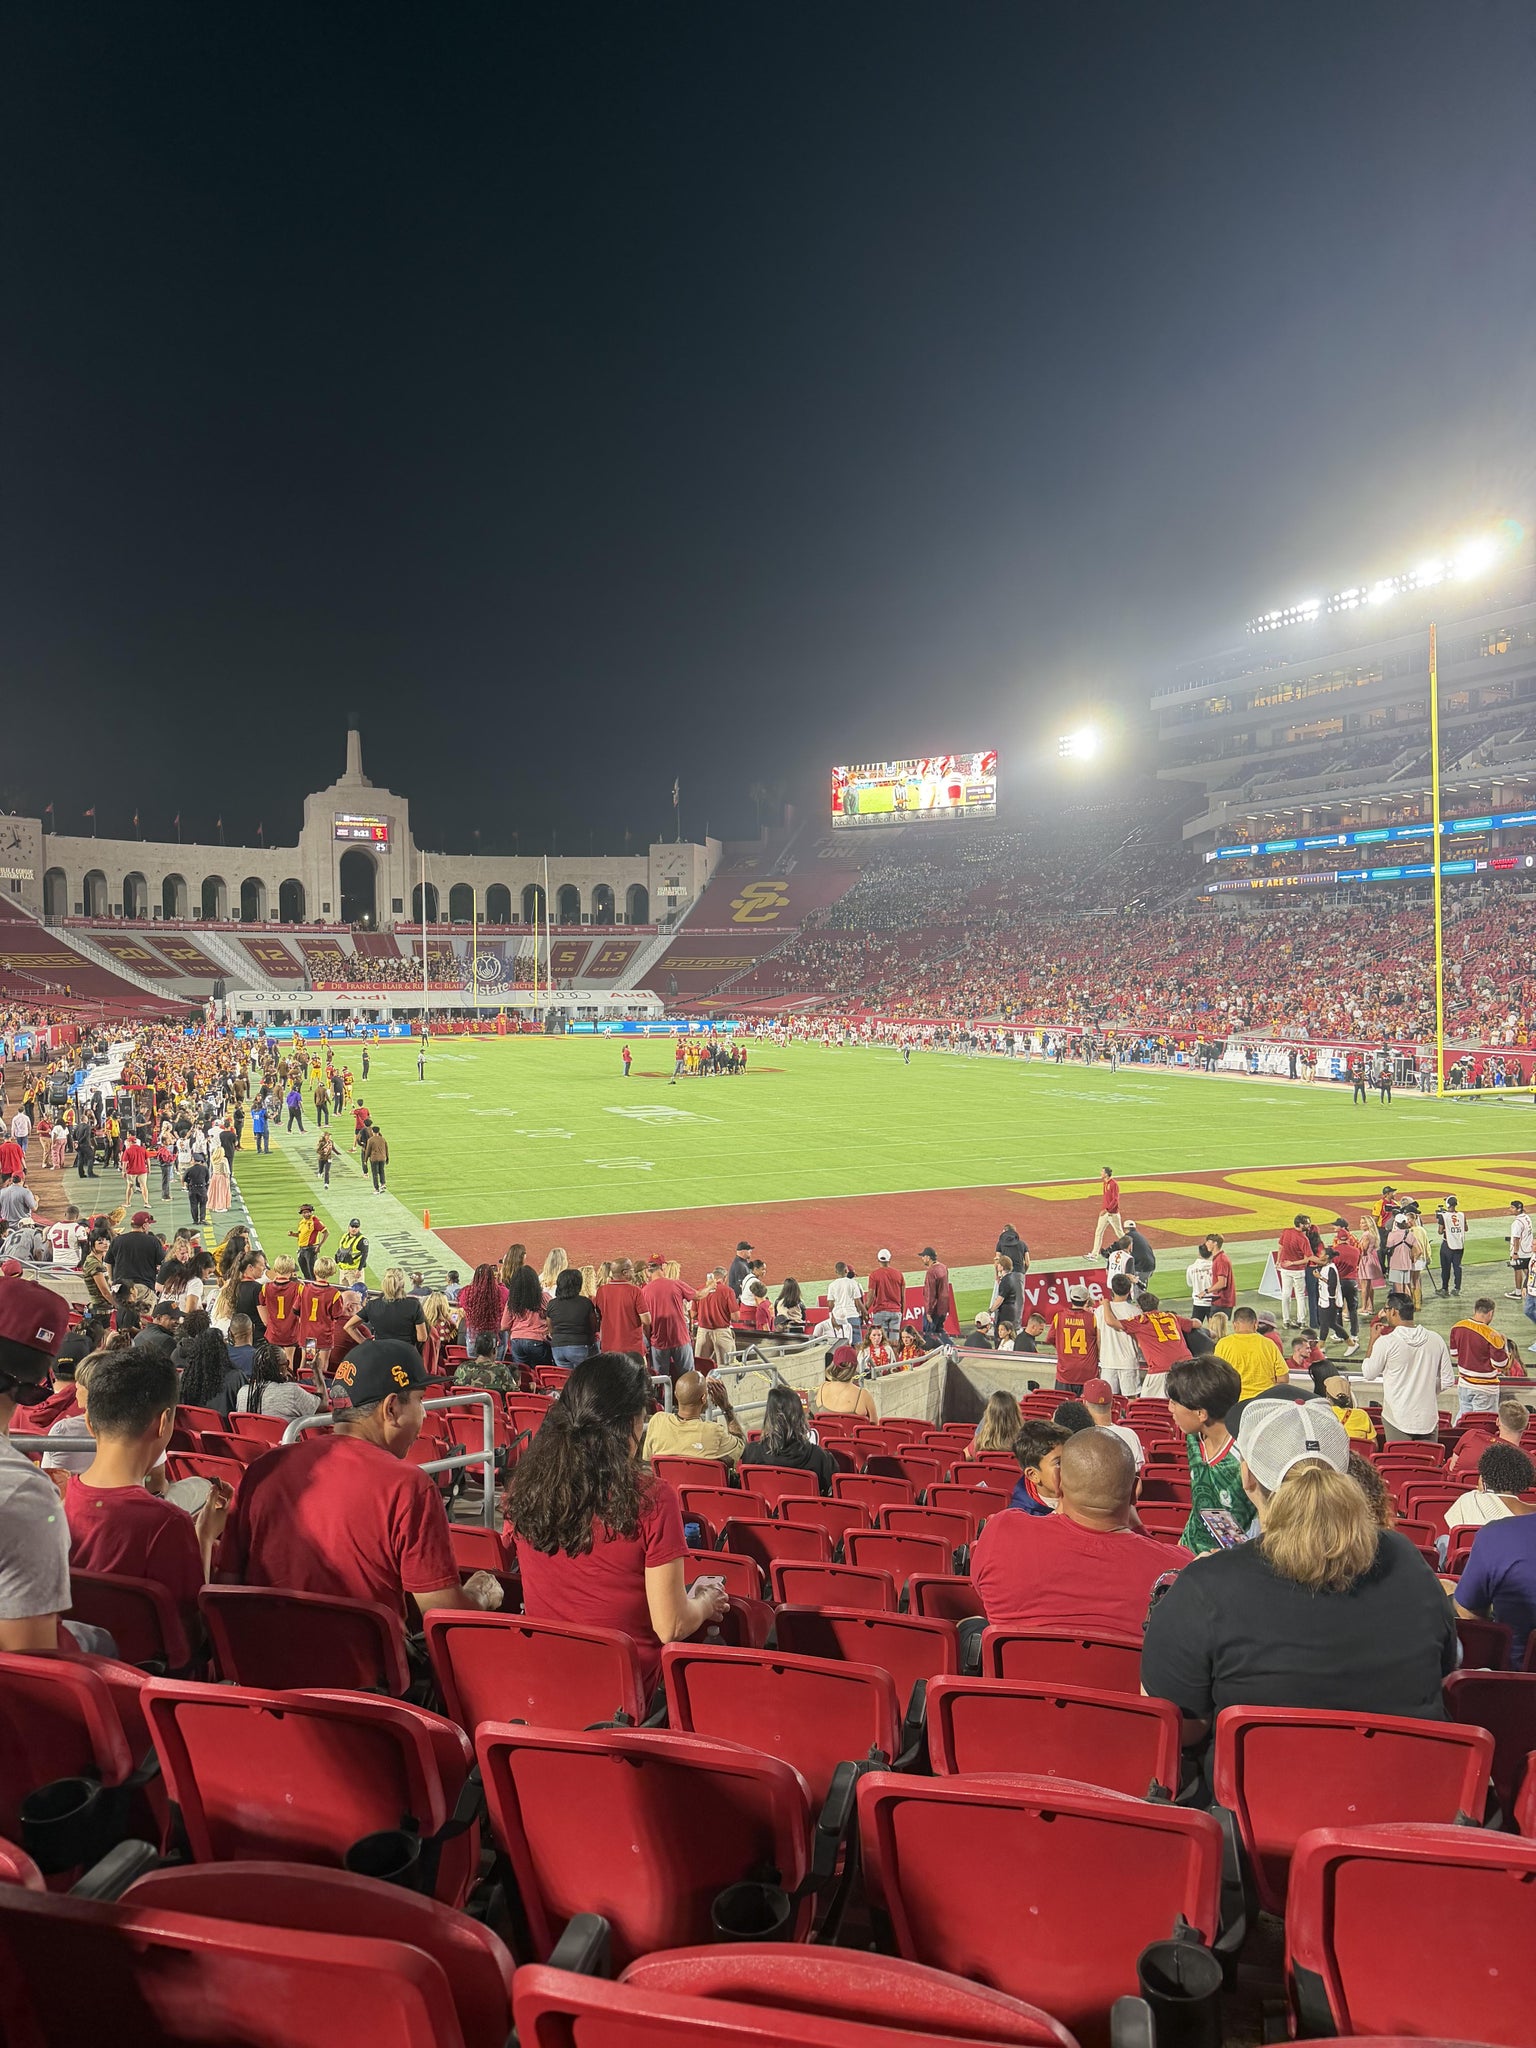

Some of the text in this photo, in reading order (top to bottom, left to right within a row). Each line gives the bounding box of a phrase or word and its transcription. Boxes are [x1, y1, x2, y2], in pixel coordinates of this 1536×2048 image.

[1250, 877, 1298, 889] WE ARE SC
[109, 947, 152, 959] 20
[162, 948, 205, 960] 32
[254, 949, 288, 960] 12
[560, 952, 577, 962] 5
[600, 952, 628, 962] 13
[52, 1230, 70, 1248] 21
[277, 1296, 285, 1319] 1
[309, 1298, 318, 1321] 1
[1063, 1328, 1088, 1354] 14
[391, 1365, 410, 1387] SC
